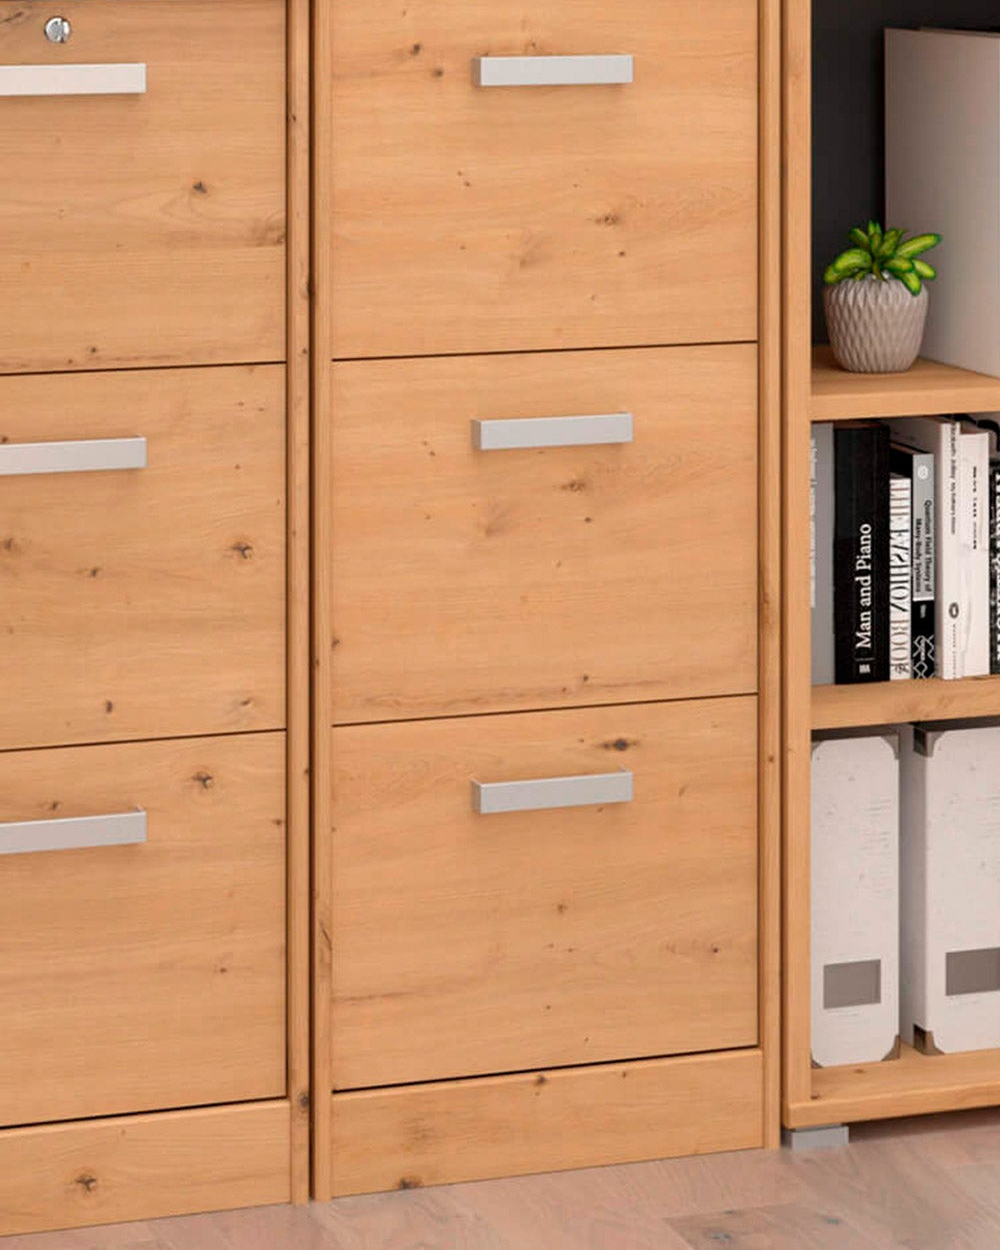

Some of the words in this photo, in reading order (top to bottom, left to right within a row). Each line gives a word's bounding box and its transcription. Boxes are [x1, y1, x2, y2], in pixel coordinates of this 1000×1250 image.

[855, 524, 871, 571] Piano
[914, 563, 922, 592] Systems
[924, 557, 932, 581] Theory
[854, 576, 871, 607] and
[925, 584, 932, 592] of
[855, 611, 871, 649] Man
